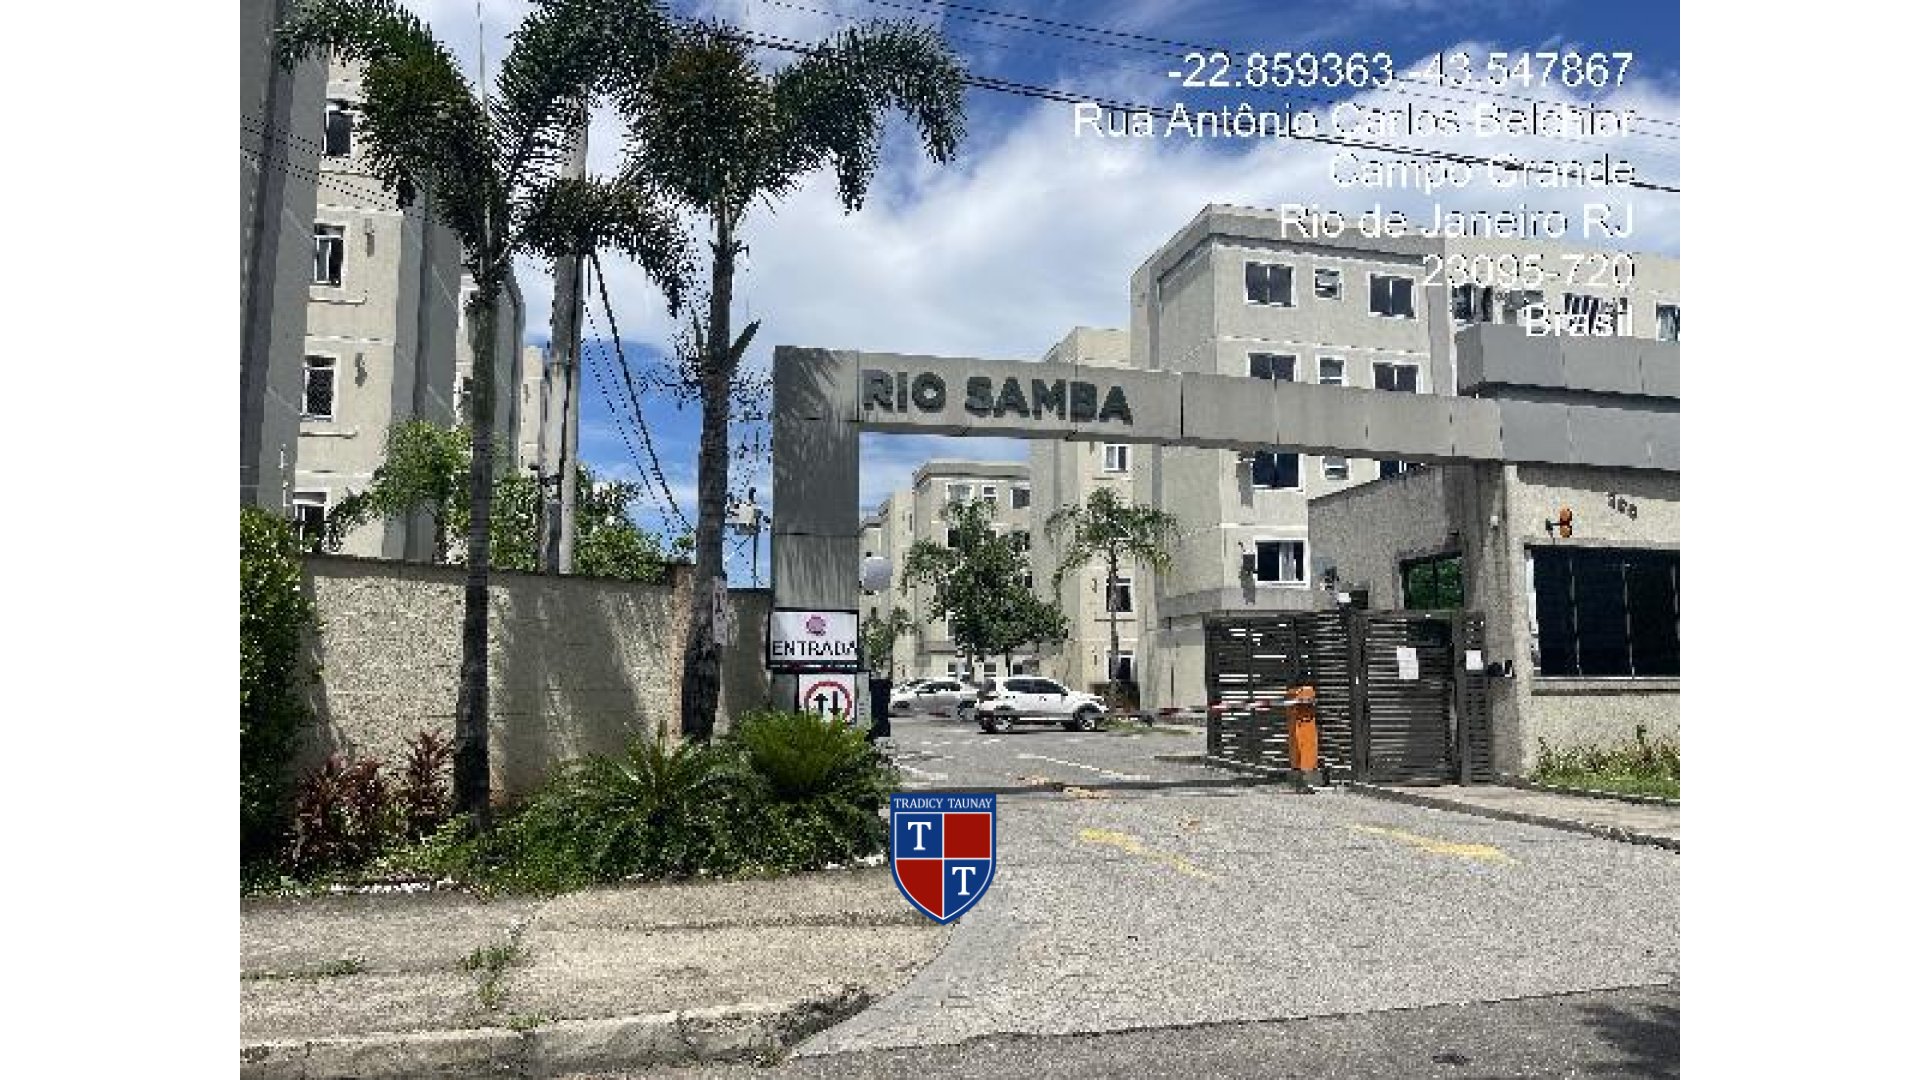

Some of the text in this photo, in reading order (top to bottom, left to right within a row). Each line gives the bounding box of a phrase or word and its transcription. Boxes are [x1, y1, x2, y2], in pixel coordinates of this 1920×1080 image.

[863, 369, 1133, 425] RIO SAMBA
[772, 640, 857, 656] ENTRADA
